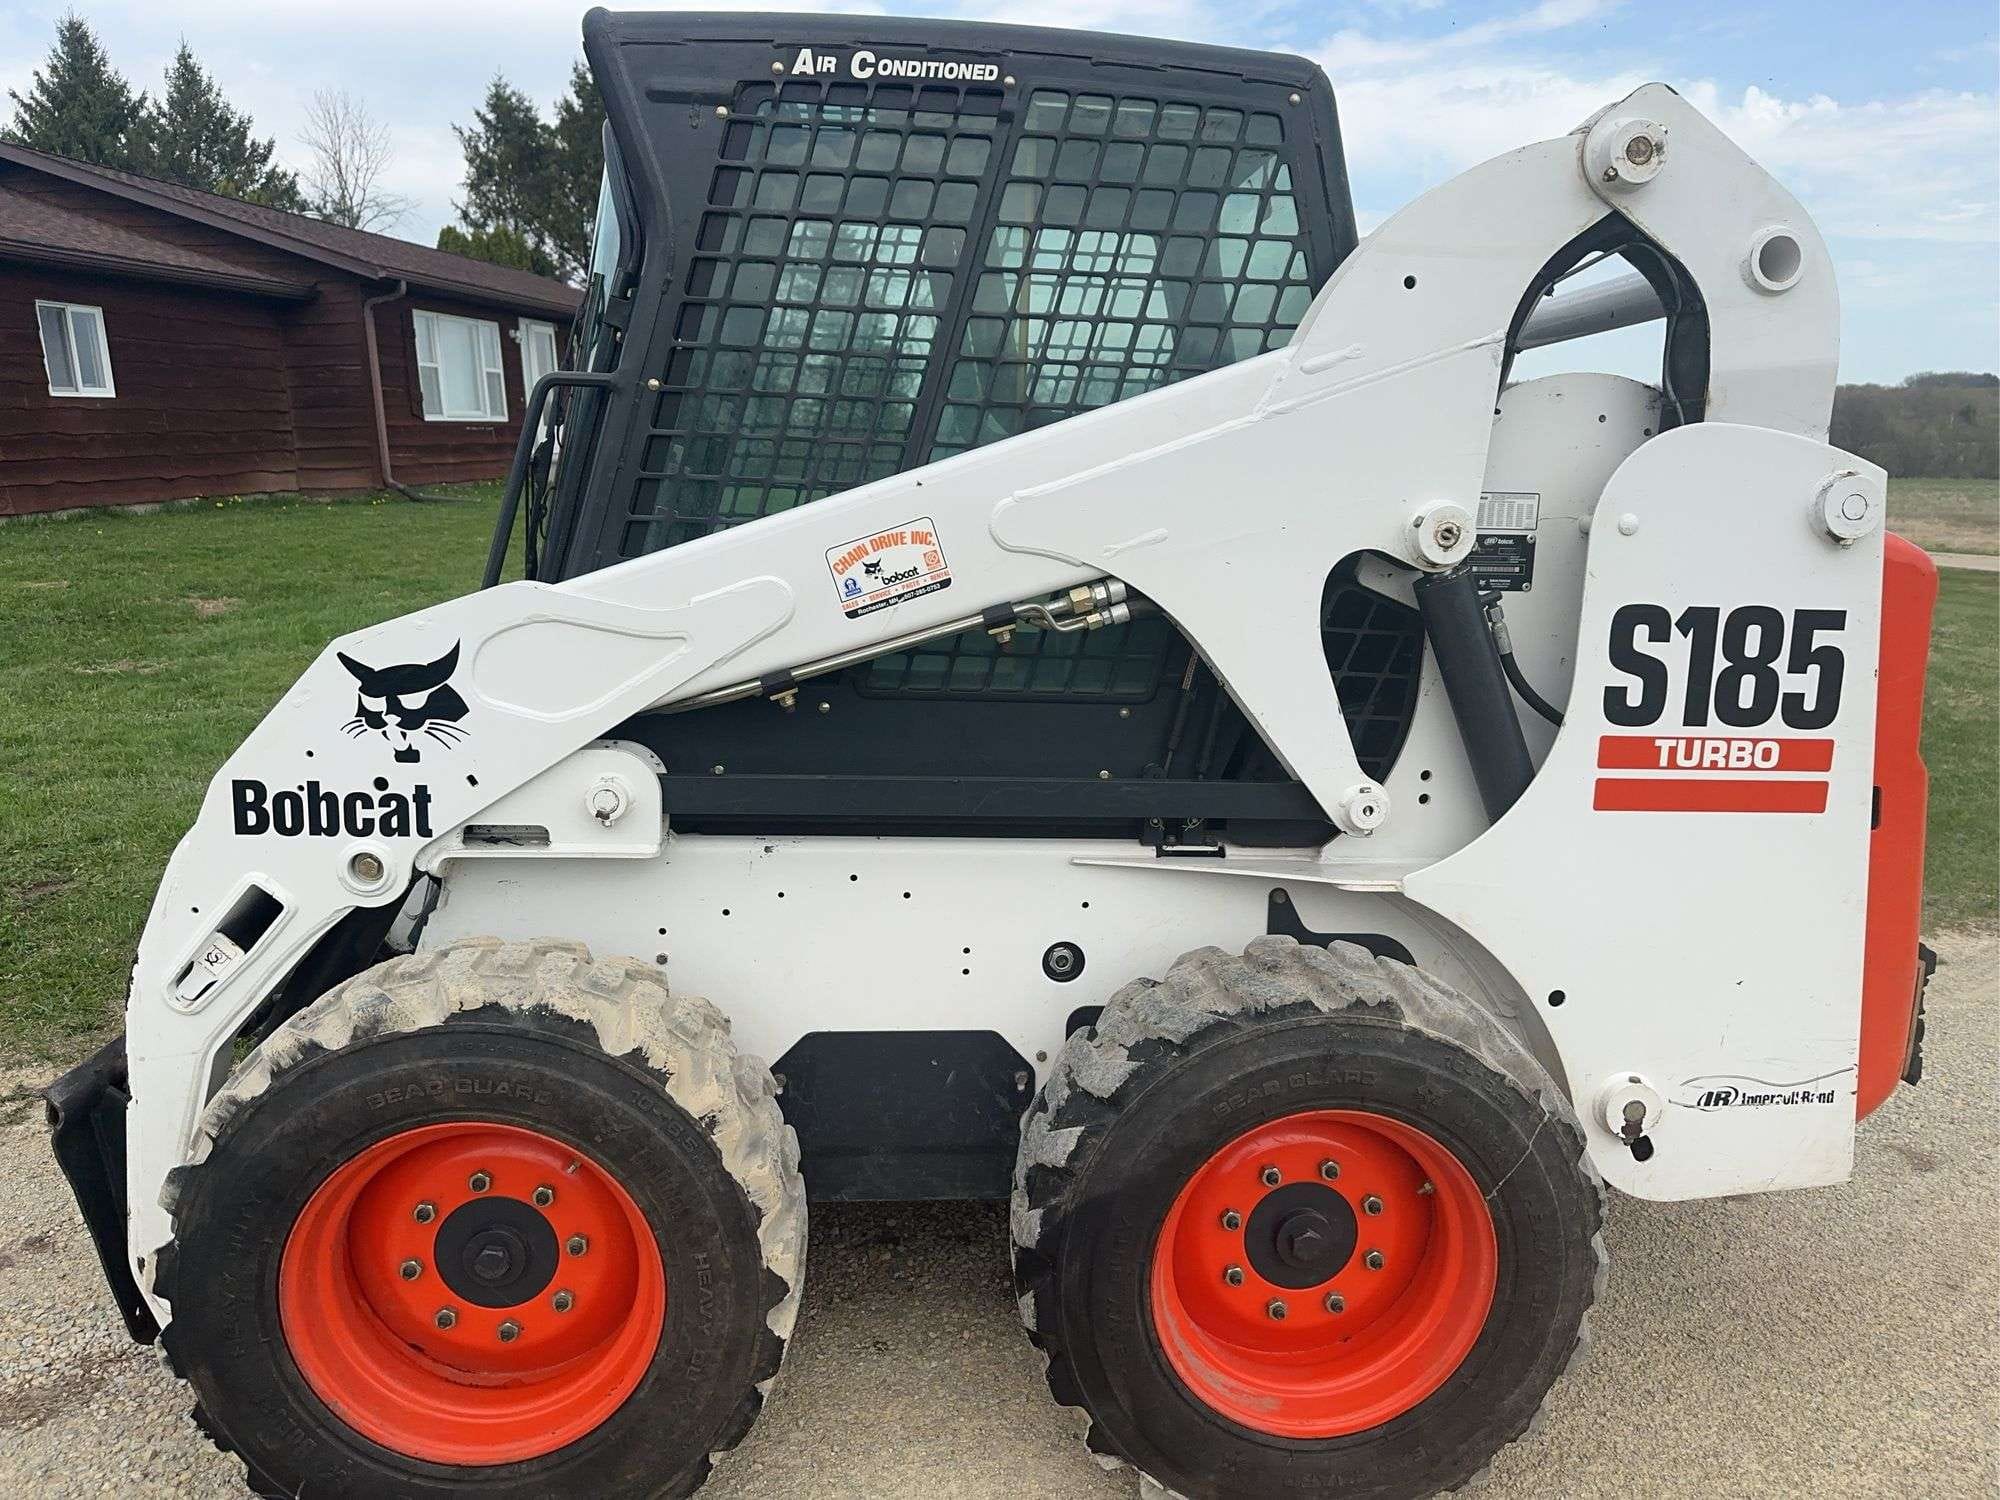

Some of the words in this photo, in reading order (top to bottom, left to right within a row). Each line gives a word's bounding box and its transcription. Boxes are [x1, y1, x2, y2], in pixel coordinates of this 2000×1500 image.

[832, 542, 870, 576] CHAIN
[868, 530, 908, 553] DRIVE
[910, 530, 936, 547] INC.
[881, 566, 919, 585] bobcat
[1602, 603, 1848, 730] S185
[1653, 738, 1781, 769] TURBO
[231, 779, 433, 838] Bobcat
